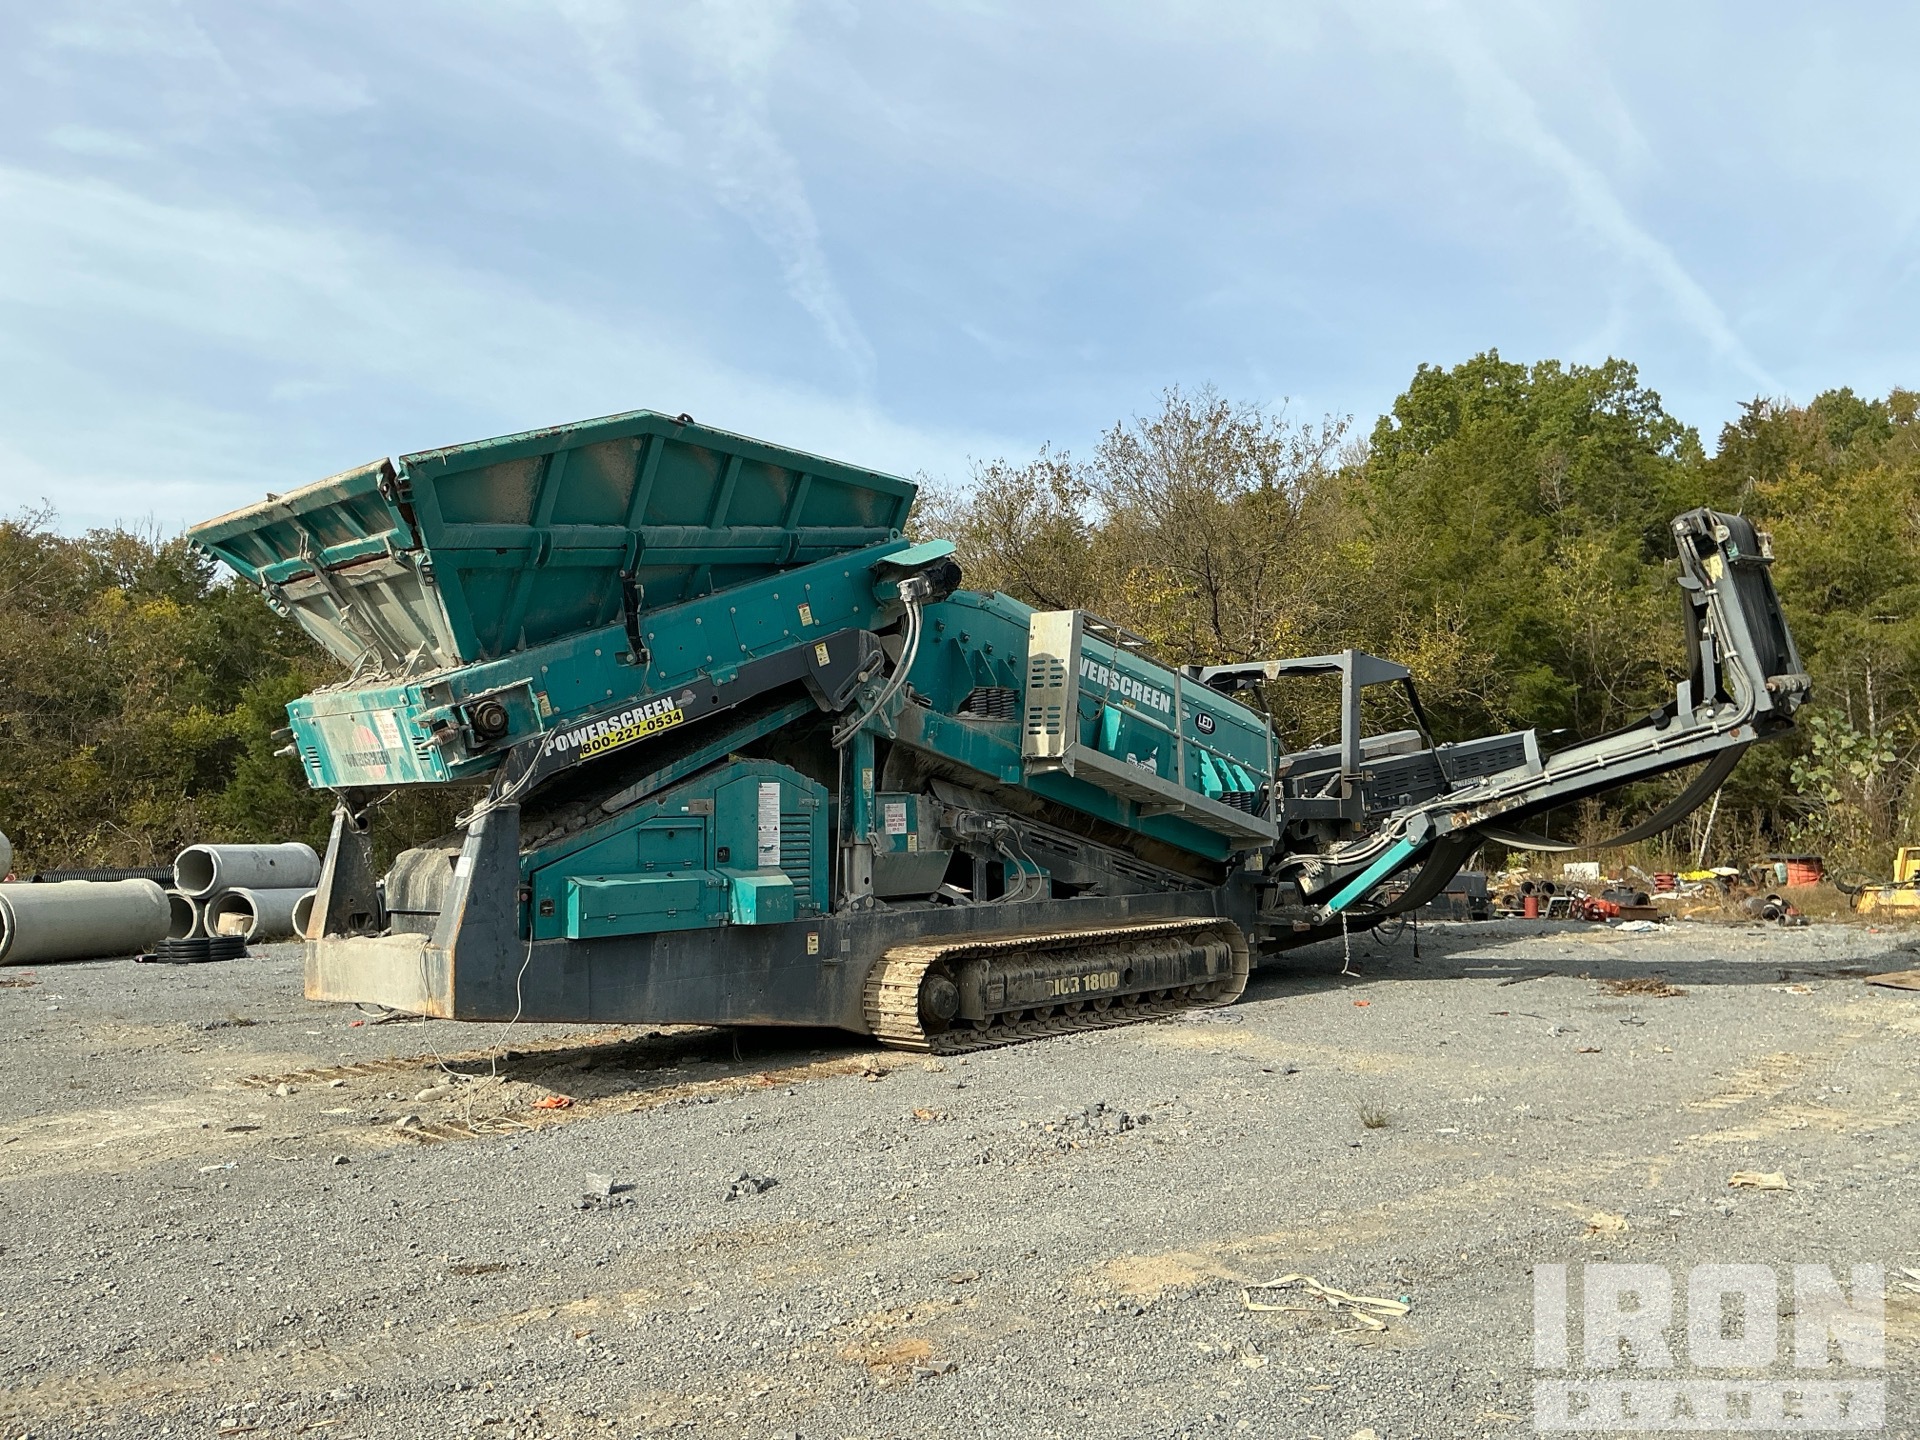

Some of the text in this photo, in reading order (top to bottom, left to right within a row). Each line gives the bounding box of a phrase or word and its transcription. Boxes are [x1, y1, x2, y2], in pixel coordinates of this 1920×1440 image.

[543, 696, 675, 757] POWERSCREEN
[583, 711, 682, 754] 800-227-0534
[1198, 714, 1213, 729] LED
[1083, 971, 1118, 991] 1800
